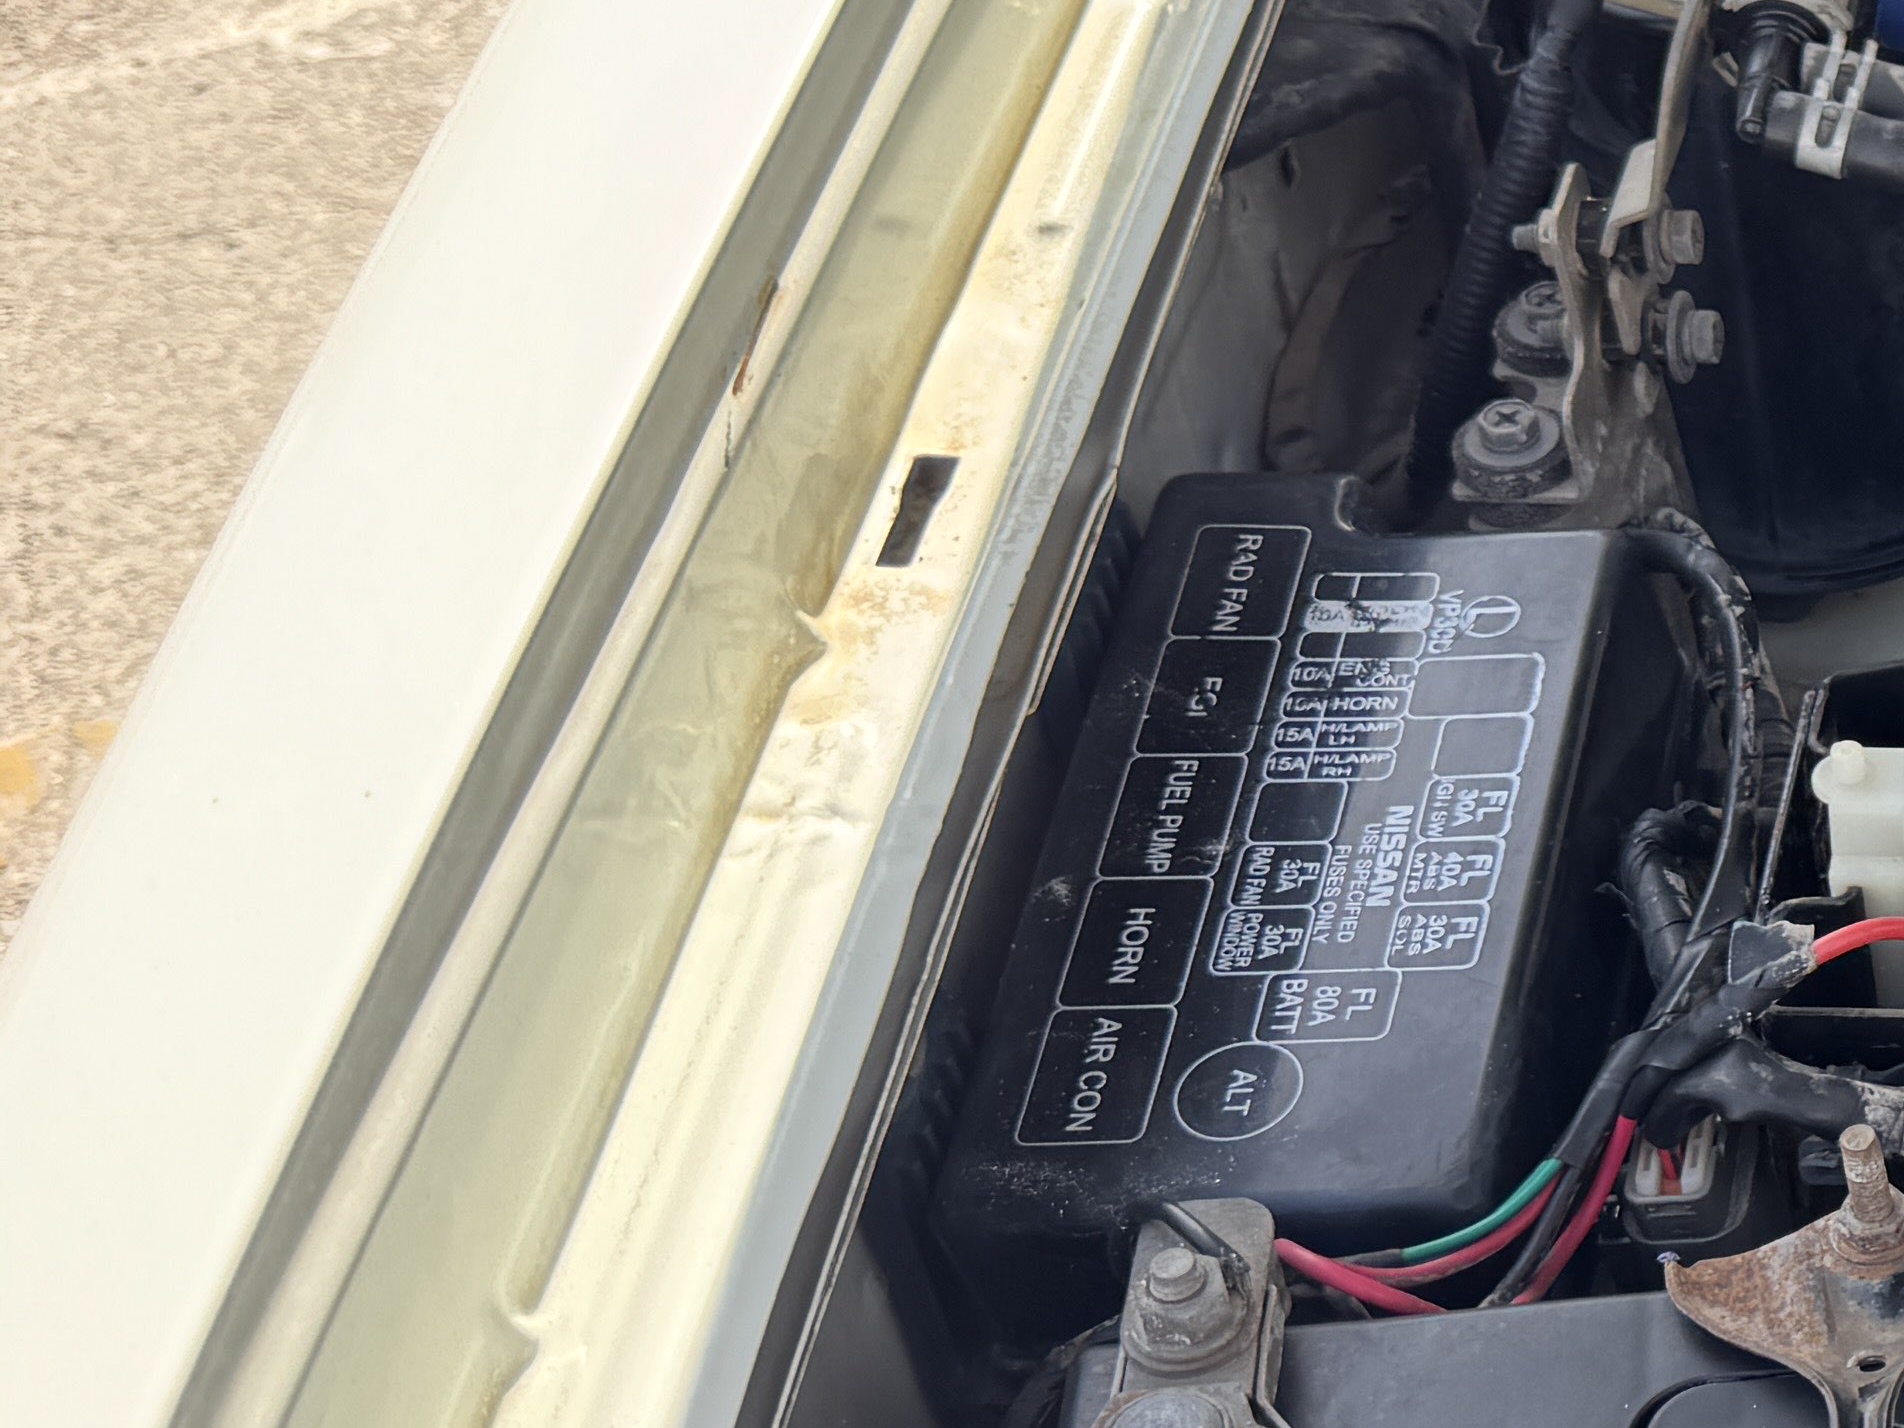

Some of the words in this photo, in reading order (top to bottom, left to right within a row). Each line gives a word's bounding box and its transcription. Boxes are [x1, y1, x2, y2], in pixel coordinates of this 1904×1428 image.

[1229, 533, 1264, 582] RAD
[1212, 587, 1248, 633] FAN
[1186, 675, 1223, 718] EGI
[1332, 697, 1398, 710] HORN
[1277, 729, 1314, 742] 15A
[1320, 722, 1398, 733] H/LAMP
[1328, 735, 1355, 745] LH
[1268, 758, 1306, 771] 15A
[1314, 753, 1392, 764] H/LAMP
[1322, 767, 1351, 777] RH
[1159, 759, 1199, 811] FUEL
[1430, 811, 1451, 836] SW
[1452, 788, 1478, 826] 30A
[1475, 790, 1509, 822] FL
[1145, 815, 1183, 874] PUMP
[1357, 822, 1383, 855] USE
[1366, 805, 1414, 907] NISSAN
[1248, 847, 1275, 875] RAD
[1275, 859, 1302, 893] 30A
[1295, 861, 1321, 888] FL
[1323, 845, 1352, 898] FUSES
[1406, 853, 1428, 894] MTR
[1422, 851, 1443, 890] ABS
[1438, 852, 1463, 892] 40A
[1459, 855, 1493, 886] FL
[1241, 878, 1266, 906] FAN
[1337, 858, 1373, 943] SPECIFIED
[1214, 911, 1245, 972] WINDOW
[1233, 912, 1264, 968] POWER
[1258, 924, 1284, 959] 30A
[1279, 928, 1303, 954] FL
[1311, 901, 1338, 944] ONLY
[1408, 913, 1428, 956] ABS
[1422, 914, 1448, 953] 30A
[1445, 916, 1479, 949] FL
[1108, 907, 1155, 985] HORN
[1271, 979, 1308, 1034] BATT
[1308, 985, 1341, 1026] 80A
[1345, 988, 1376, 1021] FL
[1085, 1018, 1123, 1065] AIR
[1065, 1071, 1107, 1133] CON
[1222, 1069, 1258, 1117] ALT
